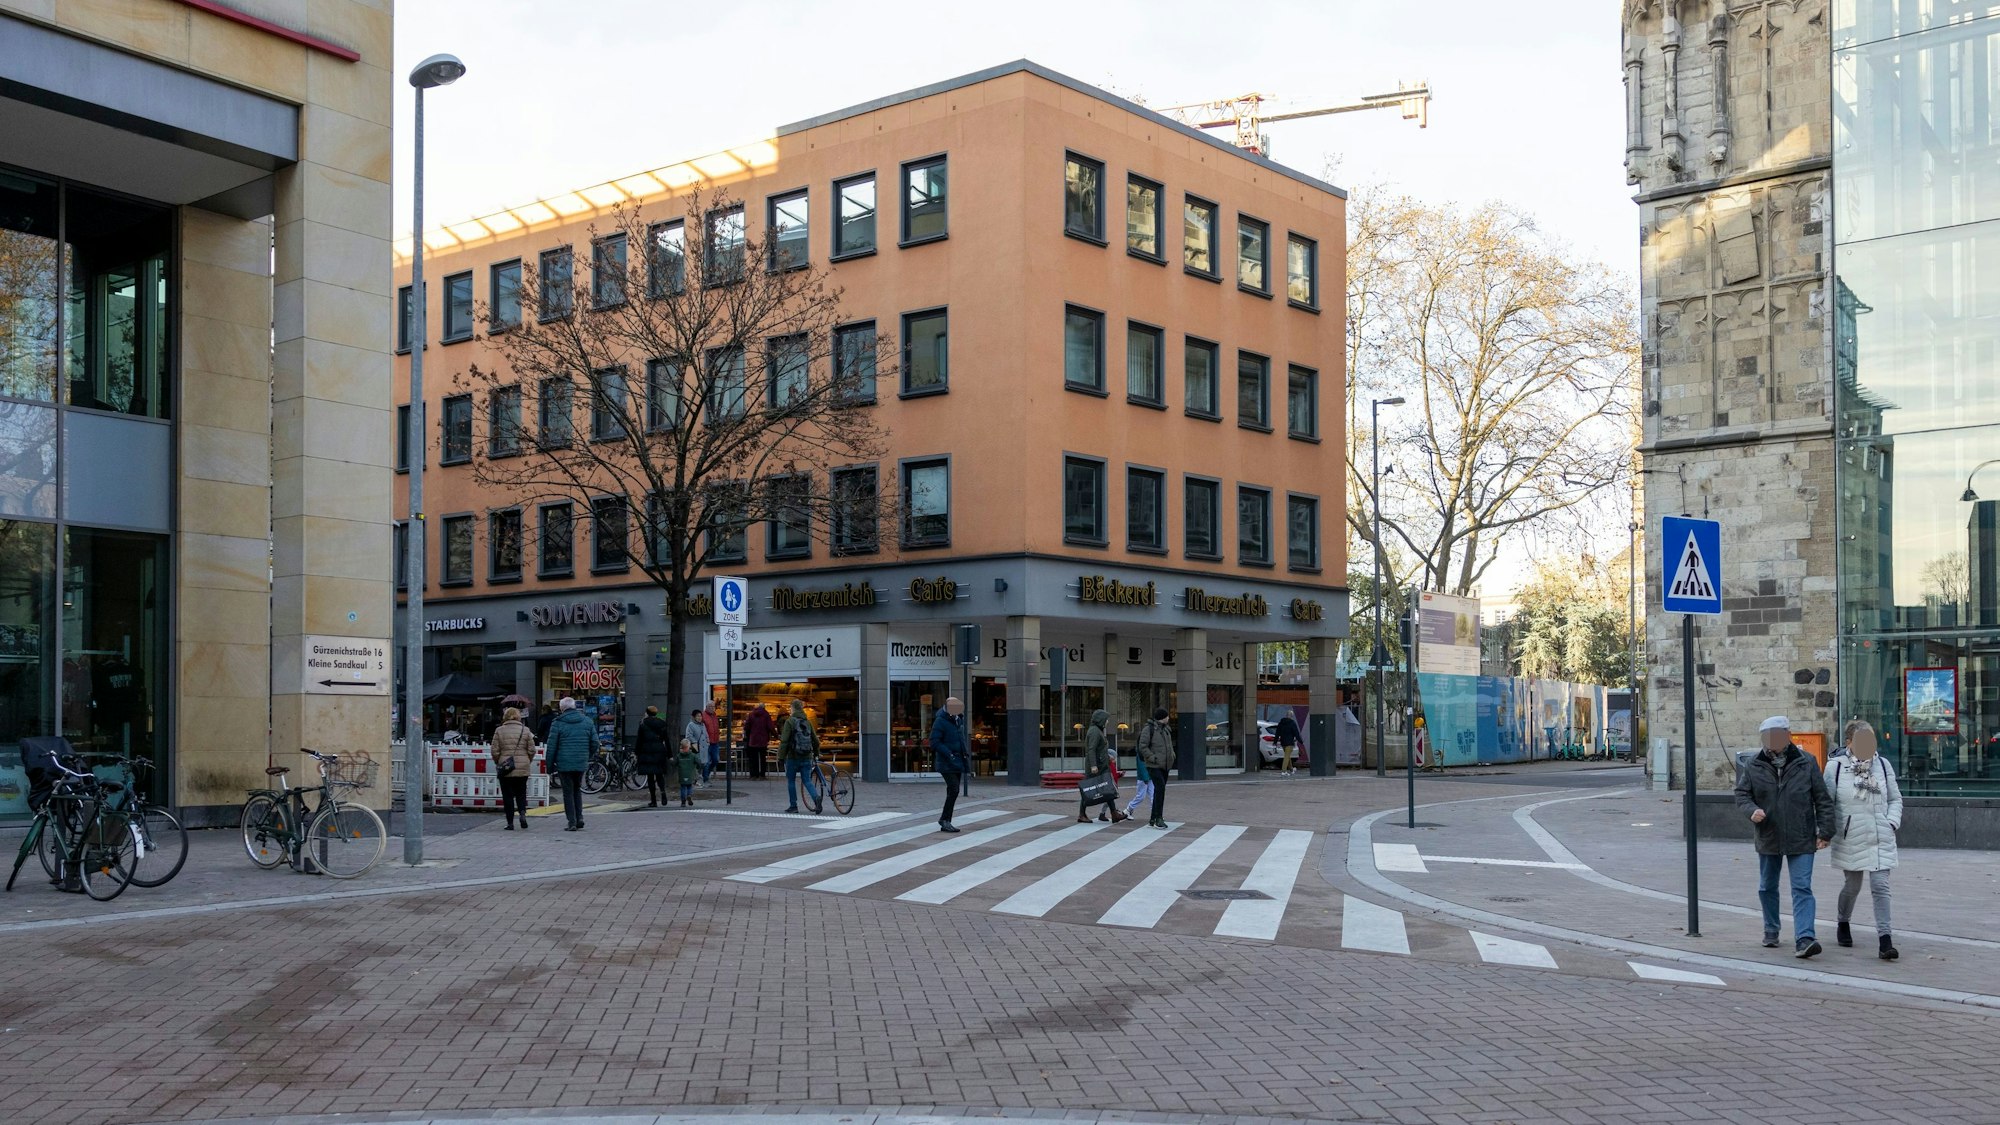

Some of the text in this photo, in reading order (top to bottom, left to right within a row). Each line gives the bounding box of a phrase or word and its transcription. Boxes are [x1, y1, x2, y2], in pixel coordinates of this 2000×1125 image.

[773, 582, 875, 610] Merzenich
[1079, 575, 1156, 607] Bäckerei
[1185, 587, 1267, 616] Merzenich
[530, 601, 621, 627] SOUVENIRS
[723, 613, 740, 622] ZONE
[424, 617, 484, 632] STARBUCKS
[313, 645, 383, 657] Gürzenichstraße 16
[733, 637, 833, 662] Bäckerei
[891, 641, 949, 657] Merzenich
[308, 659, 383, 670] Kleine Sandkaul 5
[565, 658, 596, 672] KIOSK
[572, 667, 624, 690] KIOSK
